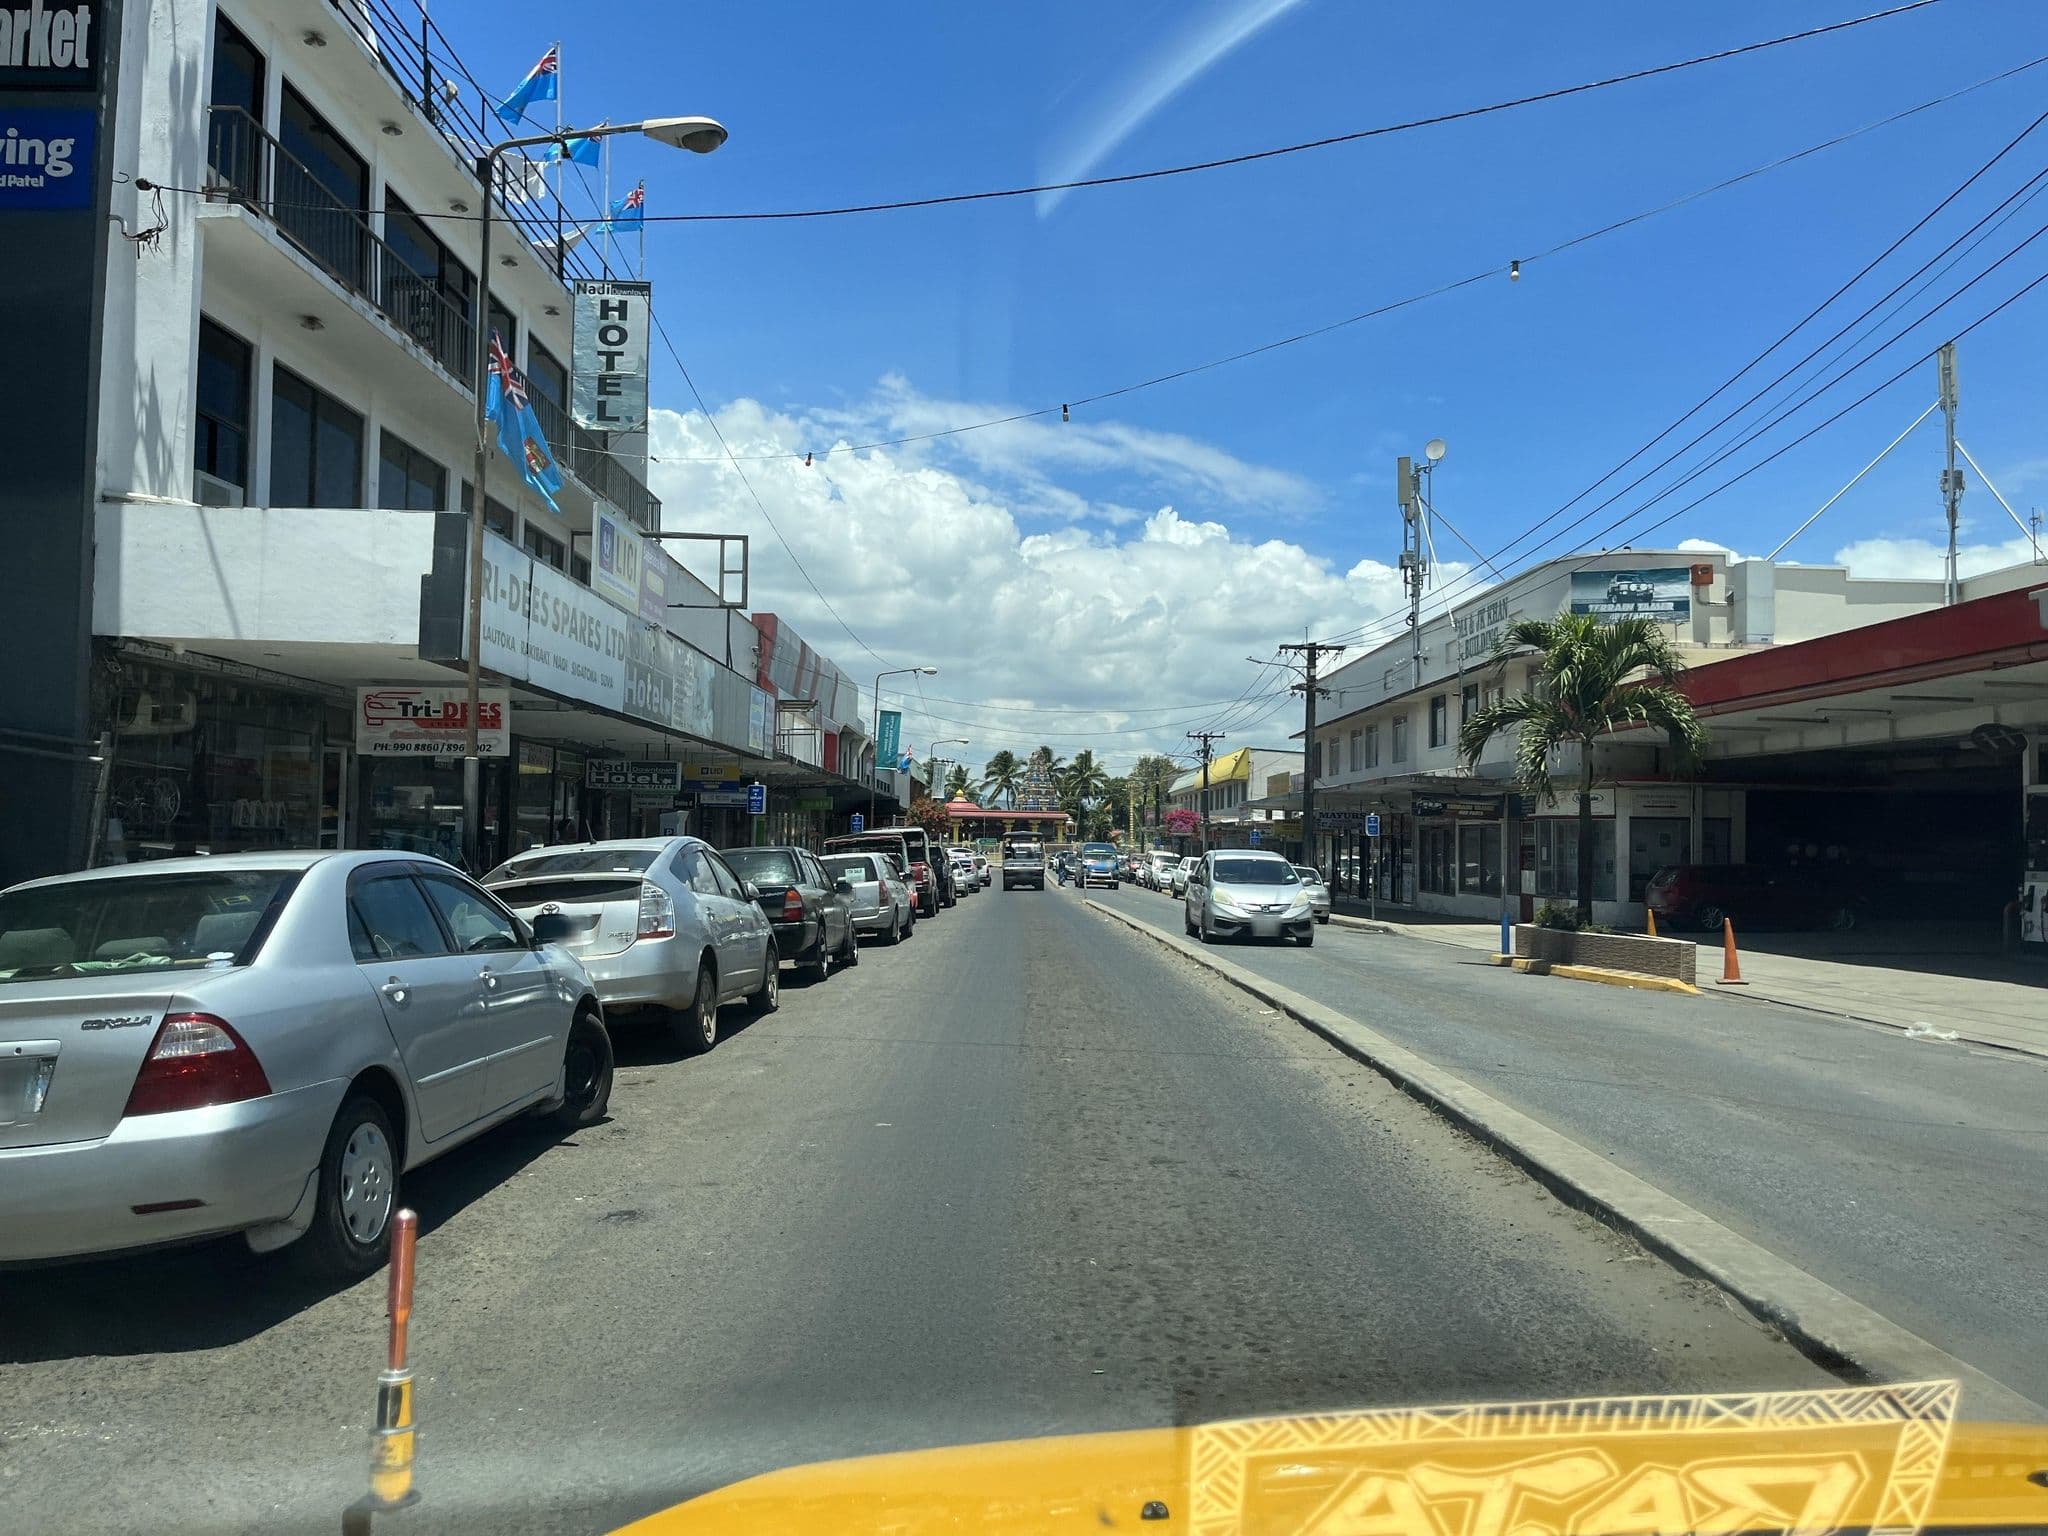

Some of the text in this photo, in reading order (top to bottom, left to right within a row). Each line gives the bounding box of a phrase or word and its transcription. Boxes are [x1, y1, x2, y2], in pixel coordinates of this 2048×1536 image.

[0, 128, 75, 177] ing
[9, 175, 44, 188] Patel
[576, 283, 610, 296] Nadi
[597, 299, 628, 422] HOTEL
[616, 535, 638, 583] LICI
[481, 558, 551, 628] RI-DEES
[552, 597, 601, 651] SPARES
[604, 625, 626, 662] LTD
[1487, 596, 1508, 627] KHAN
[482, 623, 516, 652] LAUTOKA
[552, 654, 568, 672] NADI
[625, 660, 665, 714] Hotel
[398, 700, 502, 720] Tri-DEES
[393, 743, 412, 752] 990
[414, 743, 439, 752] 8860
[588, 760, 630, 772] Nadi
[590, 772, 660, 784] Hotel
